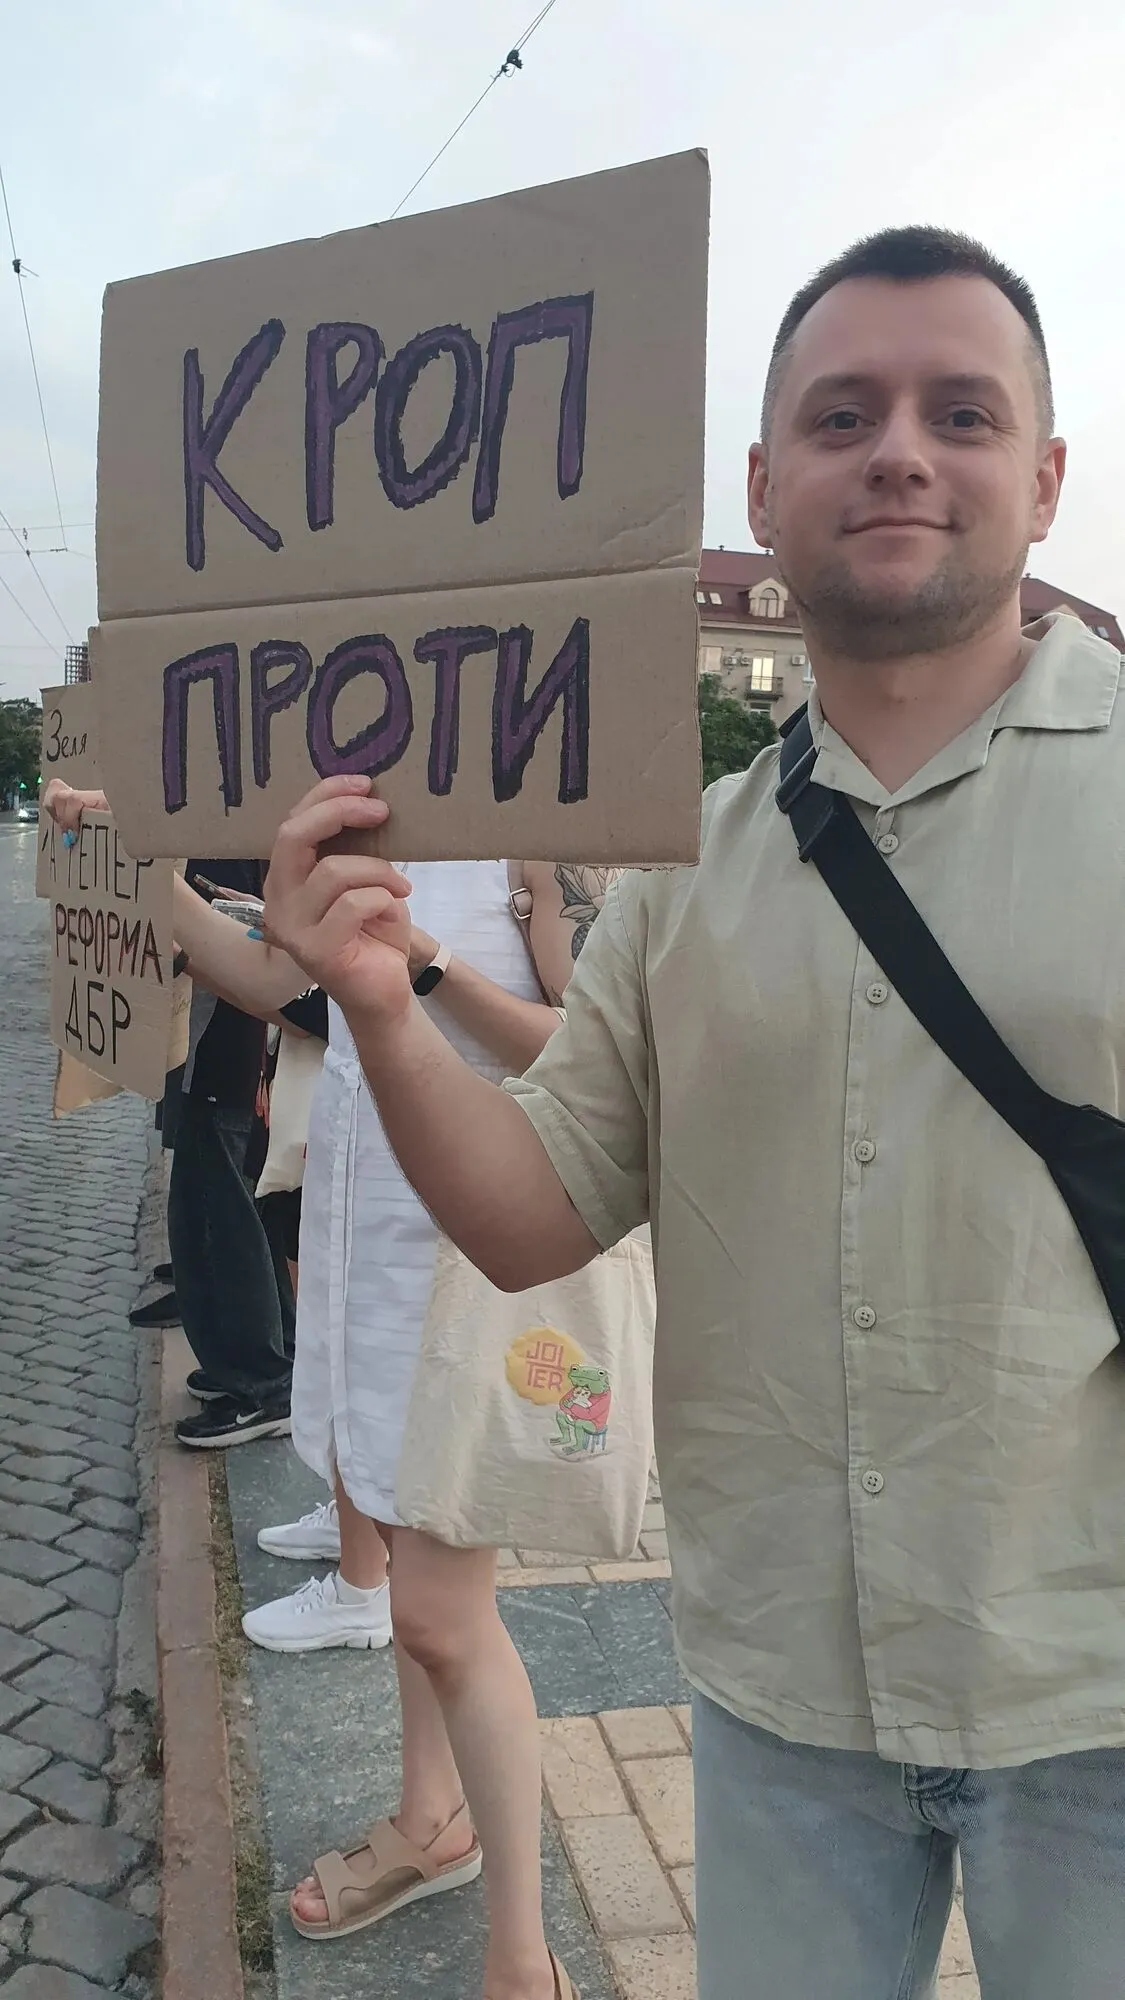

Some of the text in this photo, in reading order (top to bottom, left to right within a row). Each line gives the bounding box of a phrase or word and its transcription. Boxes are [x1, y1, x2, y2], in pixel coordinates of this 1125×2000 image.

[183, 291, 595, 571] КРОП
[162, 616, 591, 816] ПРОТИ
[55, 903, 164, 985] РЕФОРМА
[65, 975, 132, 1065] ДБР
